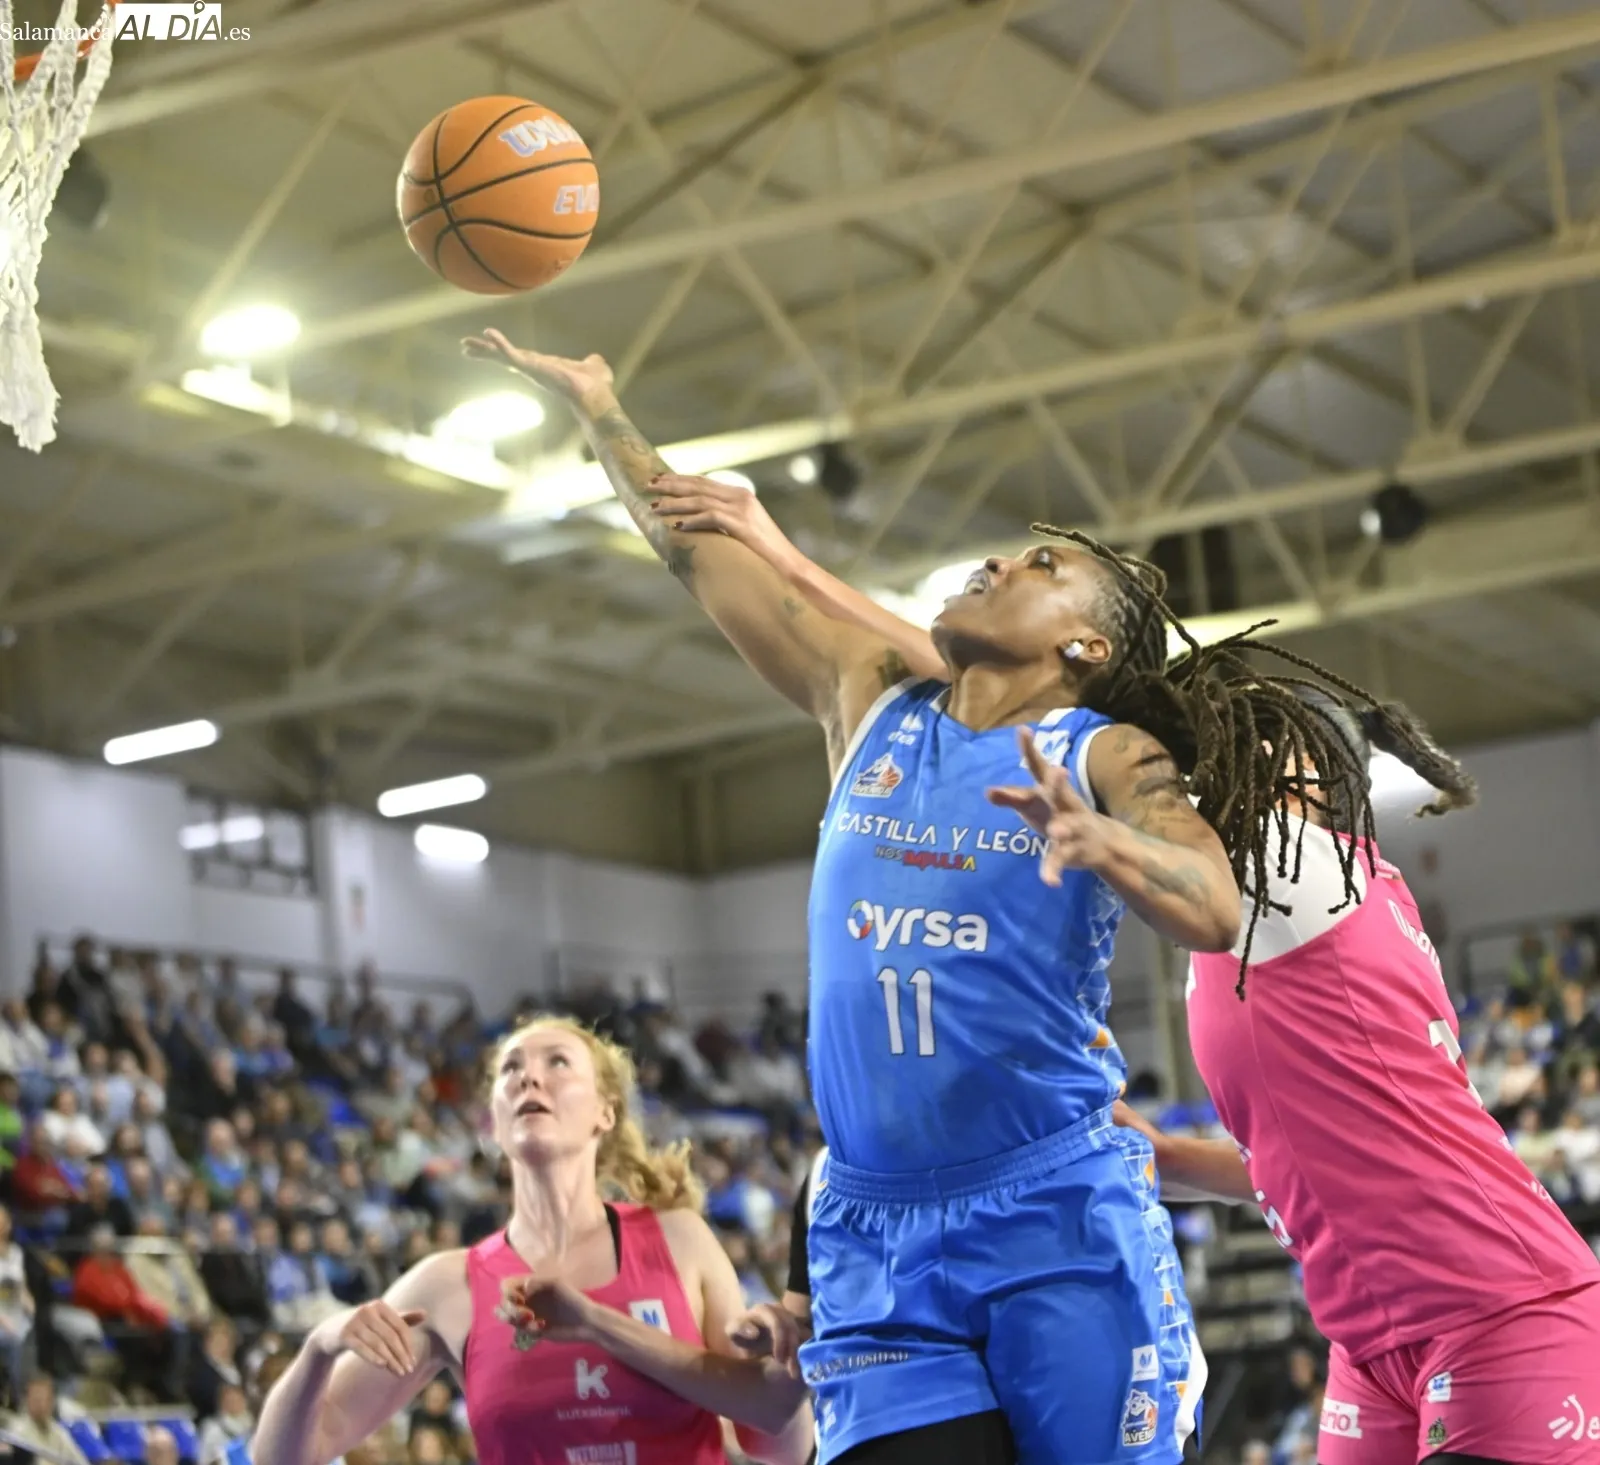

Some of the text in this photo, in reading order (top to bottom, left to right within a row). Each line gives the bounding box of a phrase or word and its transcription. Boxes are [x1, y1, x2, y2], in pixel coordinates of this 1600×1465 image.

[836, 812, 1049, 857] CASTILLA Y LEÓN
[877, 967, 936, 1056] 11
